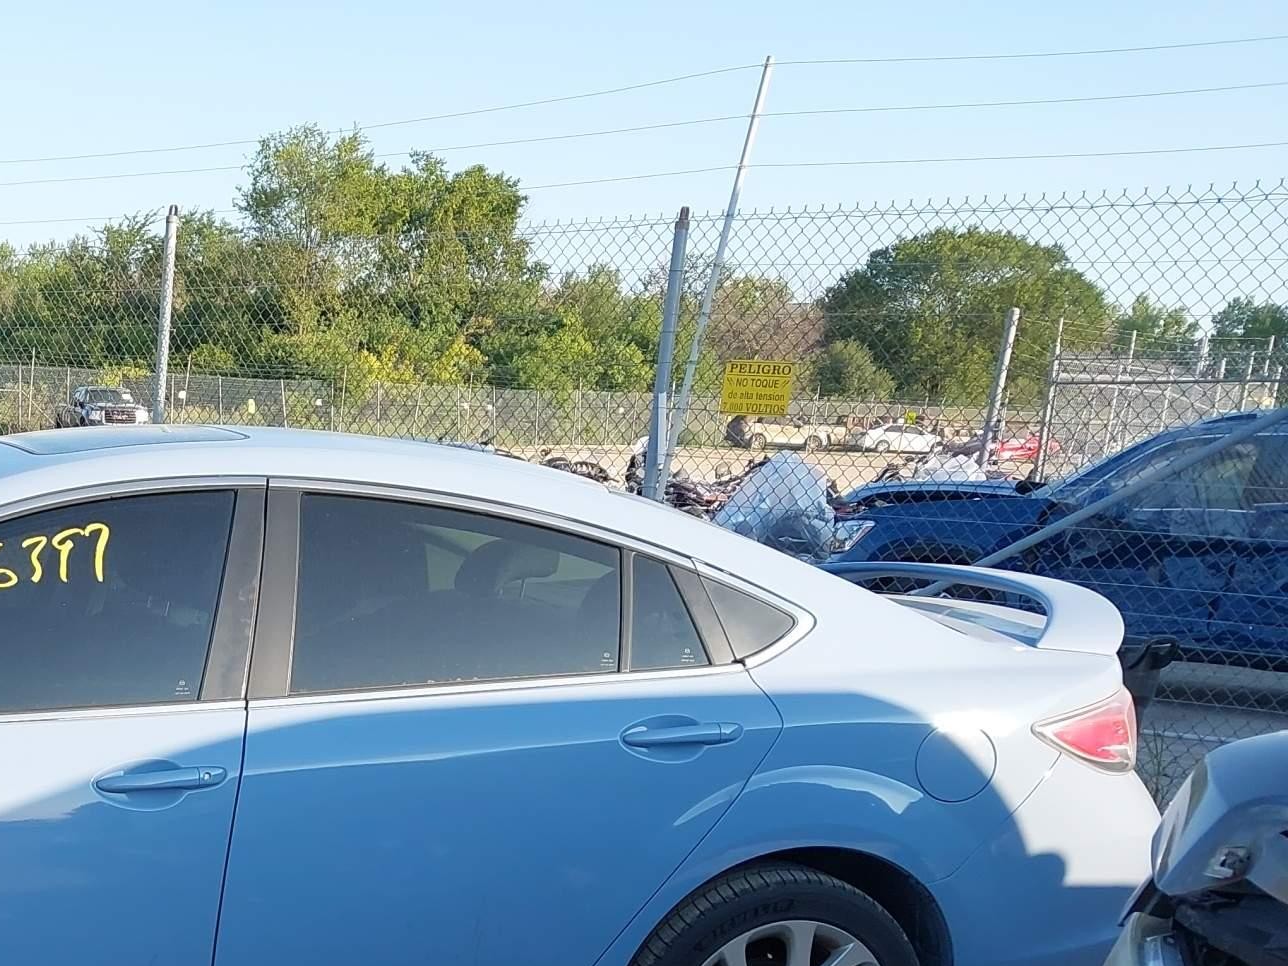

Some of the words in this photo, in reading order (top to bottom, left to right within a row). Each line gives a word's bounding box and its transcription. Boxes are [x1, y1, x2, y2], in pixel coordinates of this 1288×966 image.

[729, 363, 792, 375] PELIGRO
[735, 377, 749, 388] NO
[751, 378, 780, 388] TOQUE
[727, 390, 738, 400] de
[739, 391, 754, 400] alta
[745, 402, 786, 414] VOLTIOS
